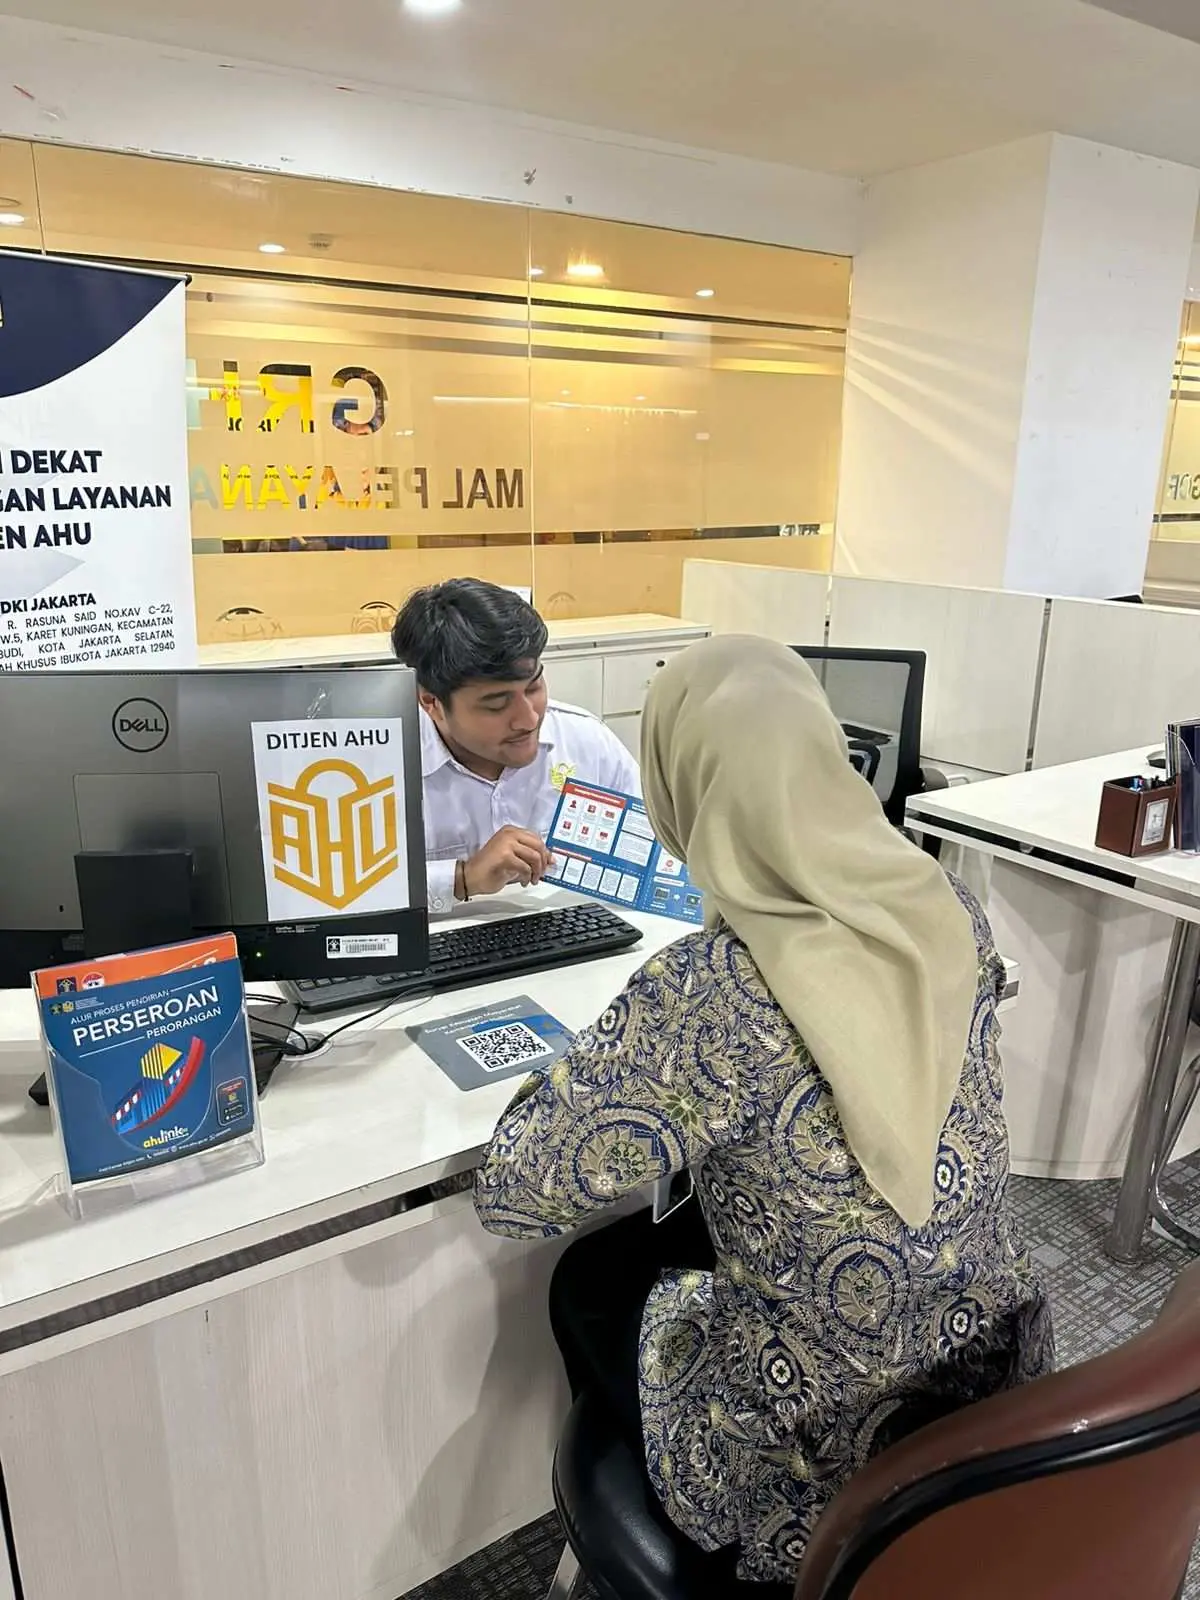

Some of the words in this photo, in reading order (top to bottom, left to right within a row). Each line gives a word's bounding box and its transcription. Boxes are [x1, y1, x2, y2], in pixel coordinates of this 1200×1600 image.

[10, 449, 102, 474] DEKAT
[0, 487, 46, 512] AN
[53, 485, 172, 510] LAYANAN
[33, 522, 92, 548] AHU
[0, 599, 28, 614] DKI
[31, 592, 97, 611] JAKARTA
[7, 619, 17, 630] R.
[25, 615, 67, 629] RASUNA
[74, 611, 97, 622] SAID
[104, 607, 141, 619] NO.KAV
[148, 603, 173, 615] C-22,
[26, 629, 57, 641] KARET
[61, 623, 114, 637] KUNINGAN,
[117, 616, 174, 631] KECAMATAN
[38, 642, 65, 654] KOTA
[79, 634, 122, 649] JAKARTA
[134, 629, 175, 642] SELATAN,
[16, 656, 57, 671] KHUSUS
[60, 650, 101, 666] IBUKOTA
[105, 644, 147, 659] JAKARTA
[150, 640, 176, 653] 12940
[119, 718, 164, 733] DELL
[266, 730, 338, 750] DITJEN
[344, 728, 391, 747] AHU
[70, 1012, 92, 1025] ALUR
[93, 1003, 125, 1019] PROSES
[125, 989, 170, 1011] PENDIRIAN
[72, 984, 219, 1047] PERSEROAN
[146, 1006, 222, 1040] PERORANGAN
